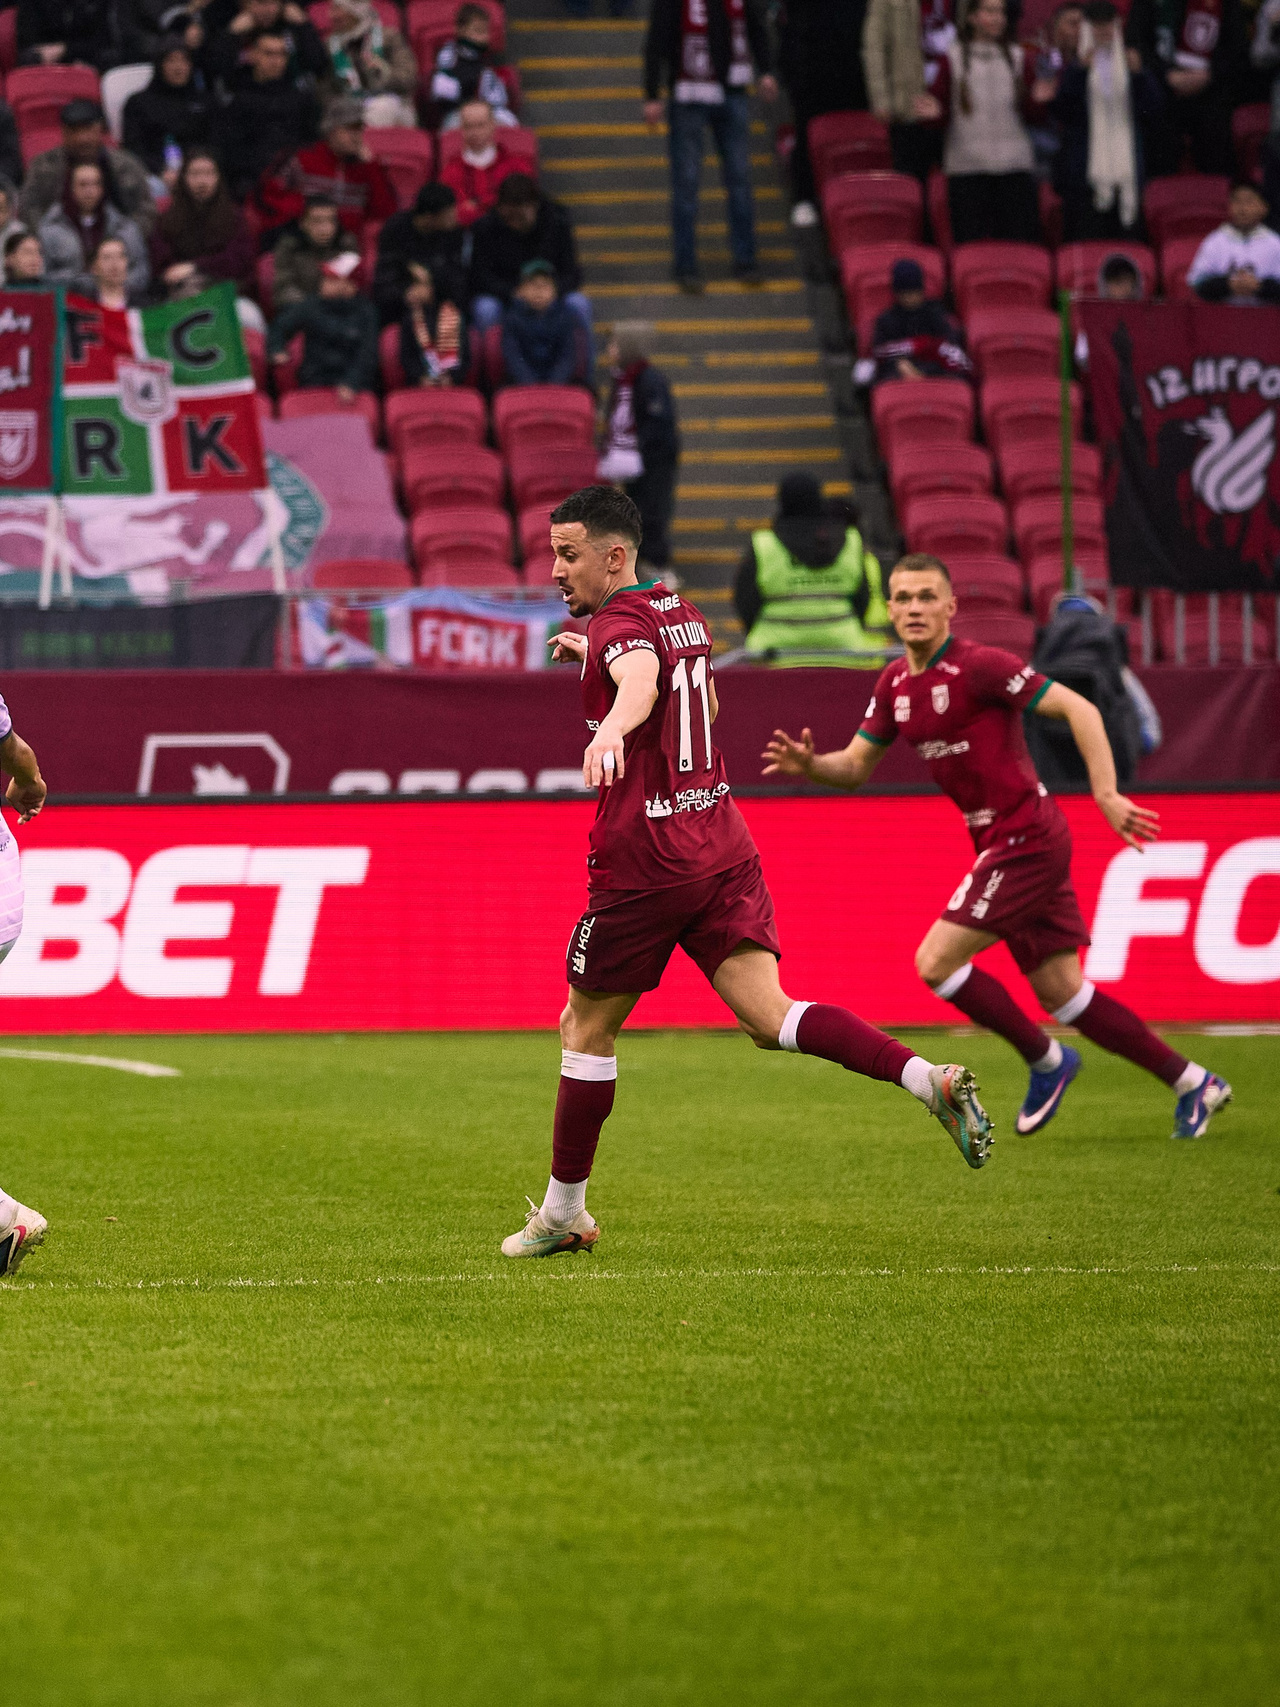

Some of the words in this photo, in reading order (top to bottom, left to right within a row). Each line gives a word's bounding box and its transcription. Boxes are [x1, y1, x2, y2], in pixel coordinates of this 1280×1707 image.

[1146, 365, 1189, 409] 12
[73, 417, 124, 480] R
[183, 416, 244, 474] K
[420, 619, 518, 664] FCRK
[672, 655, 712, 772] 11
